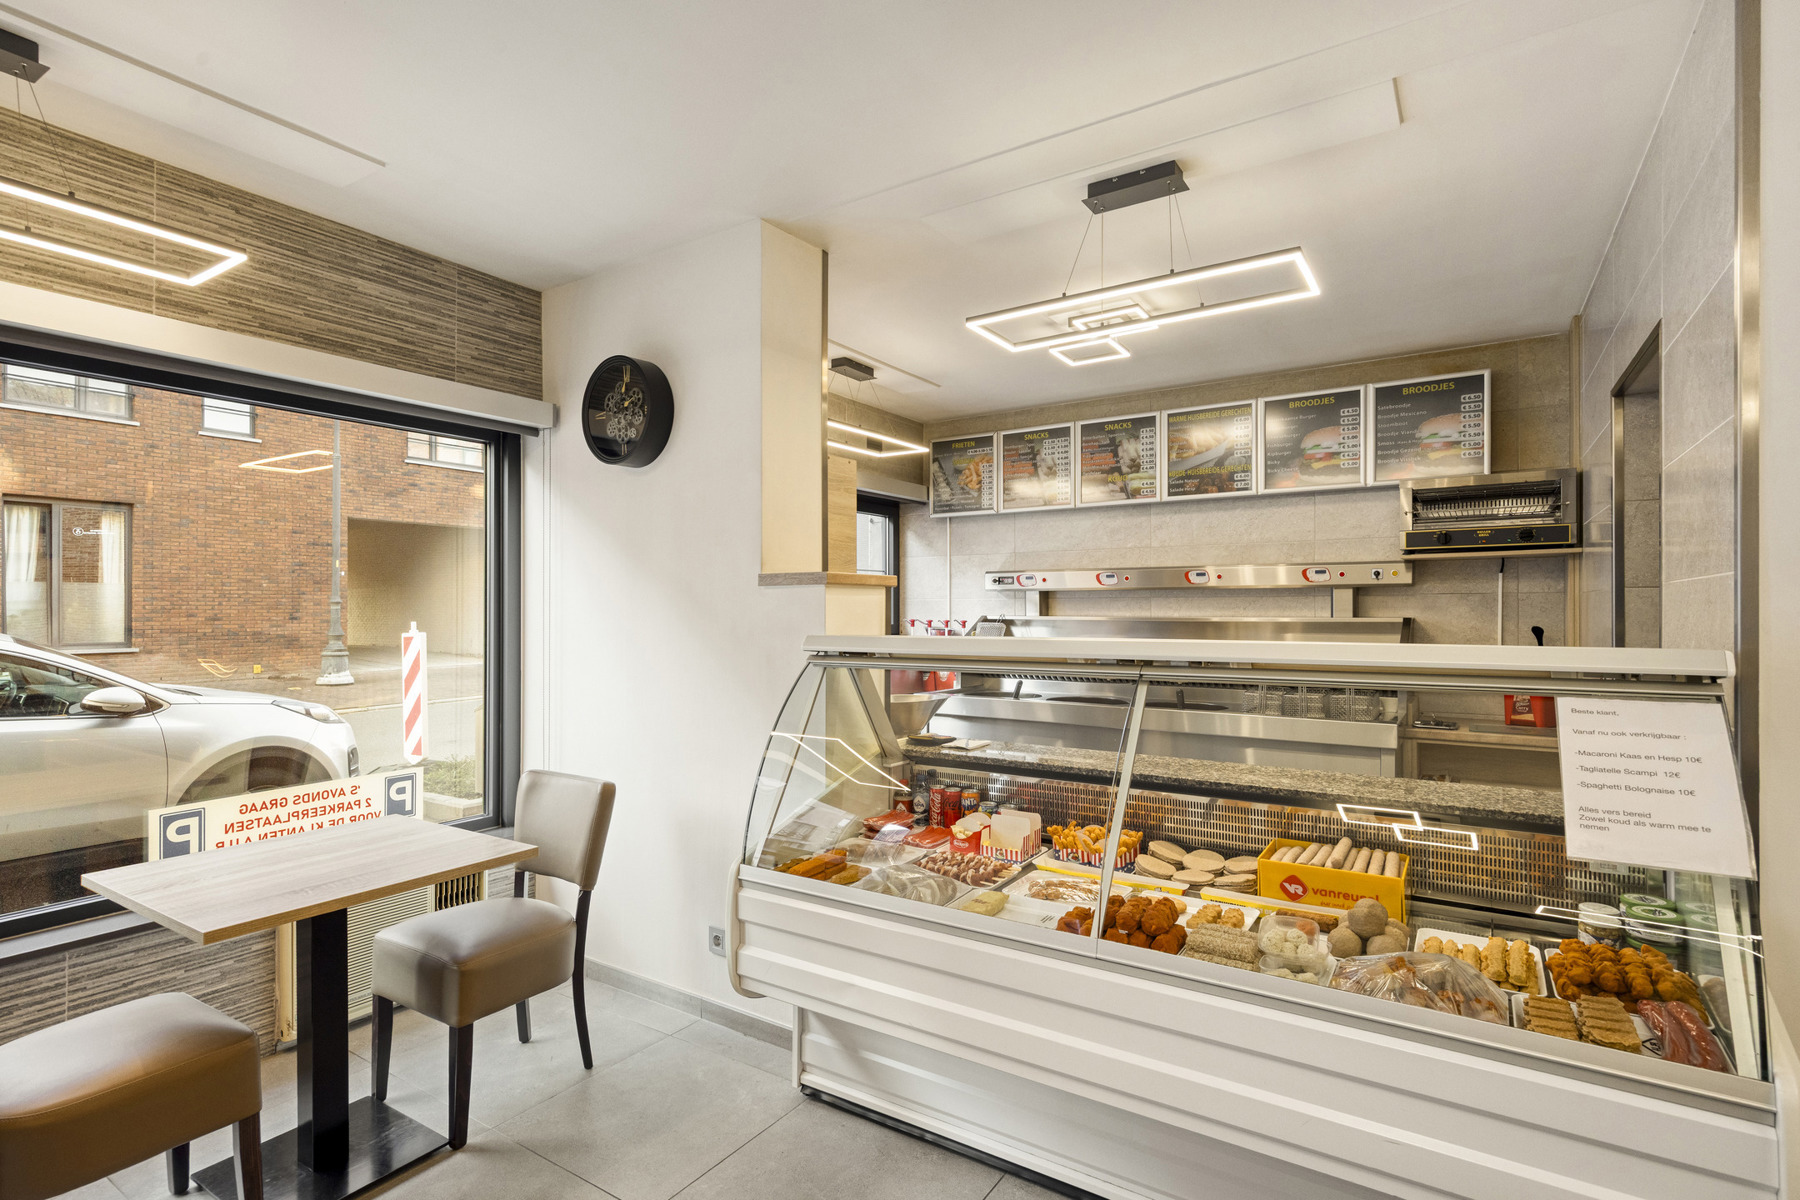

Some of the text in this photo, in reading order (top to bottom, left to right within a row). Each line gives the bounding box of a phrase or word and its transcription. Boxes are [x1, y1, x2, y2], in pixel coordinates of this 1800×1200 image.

[1402, 382, 1455, 395] BROODJES
[1289, 396, 1335, 408] BROODJES
[1221, 407, 1252, 417] GERECHTEN
[1104, 422, 1132, 431] SNACKS
[1024, 432, 1049, 440] SNACKS
[1221, 464, 1252, 472] GERECHTEN
[1576, 765, 1621, 774] -Tagliatelle
[1624, 769, 1658, 777] Scampi
[1577, 781, 1622, 790] -Spaghetti
[1625, 785, 1675, 795] Bolognaise
[1579, 814, 1606, 822] Zowel
[1608, 817, 1631, 825] koud
[1623, 810, 1651, 818] bereid
[1282, 882, 1304, 896] VR
